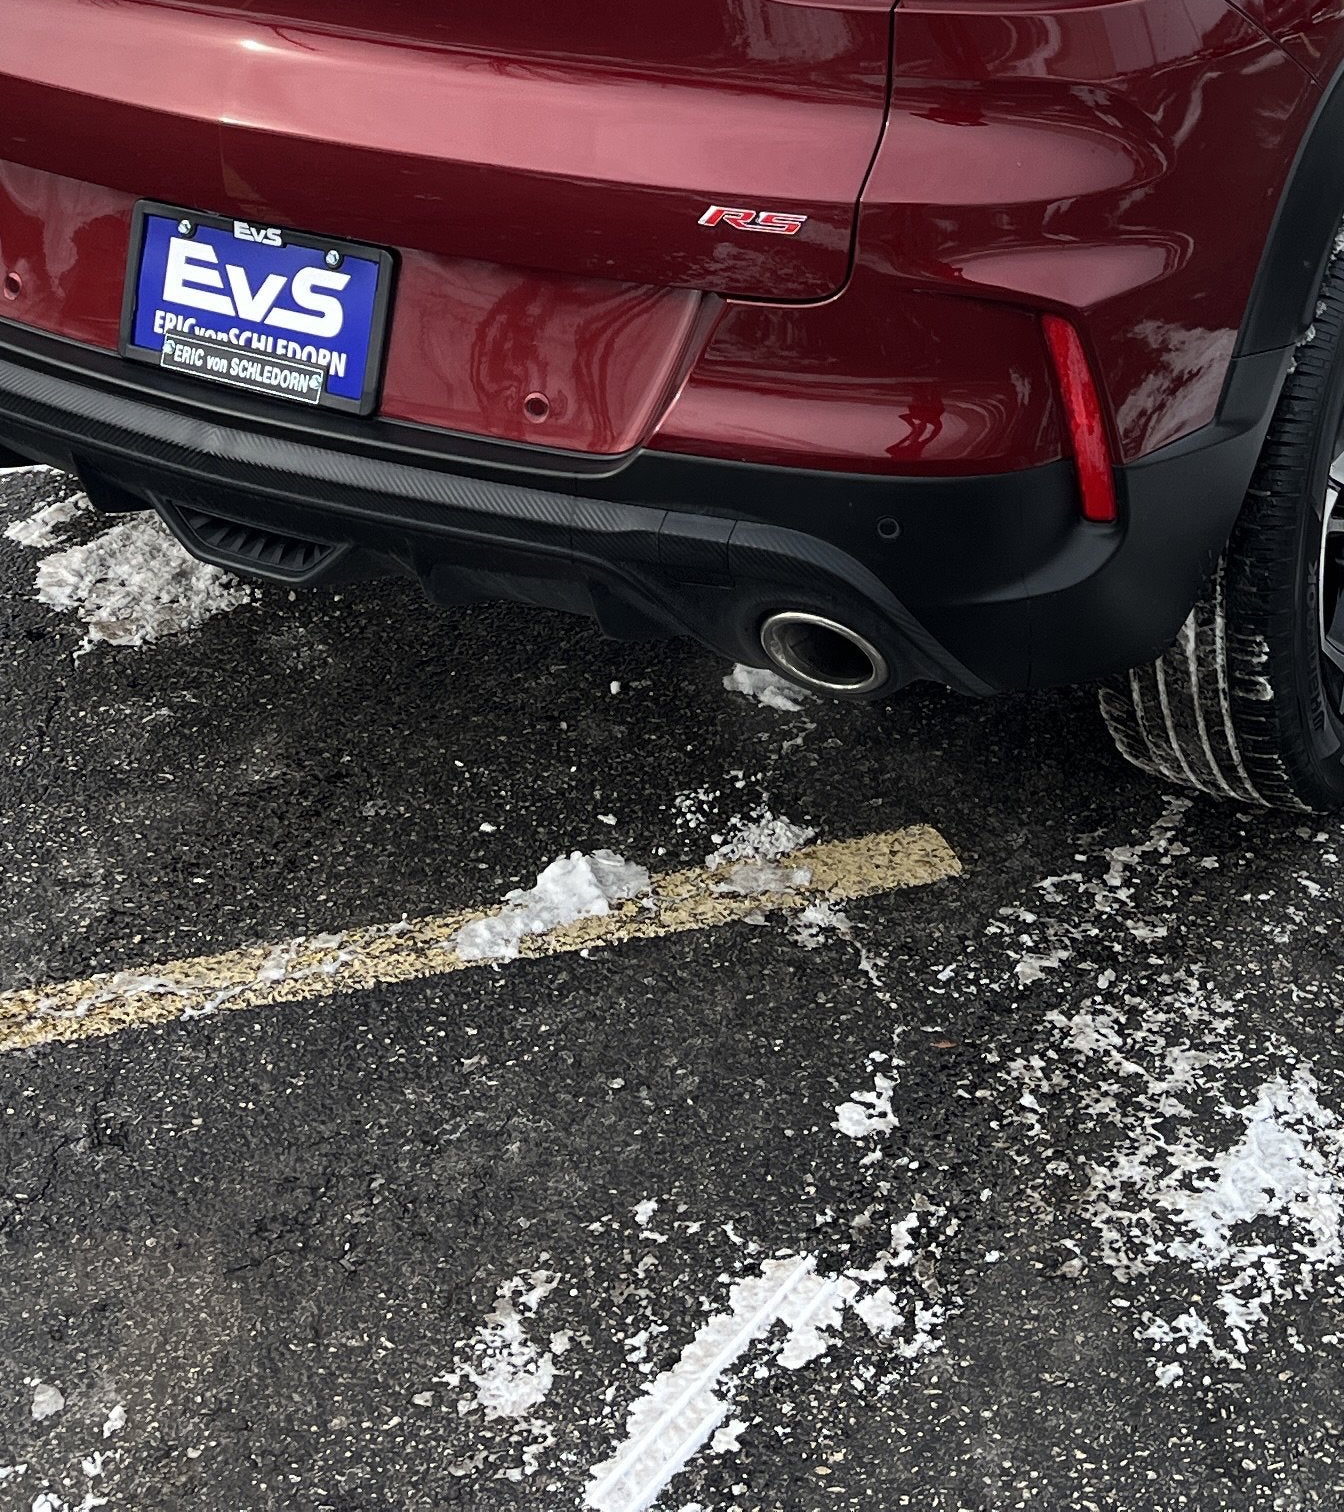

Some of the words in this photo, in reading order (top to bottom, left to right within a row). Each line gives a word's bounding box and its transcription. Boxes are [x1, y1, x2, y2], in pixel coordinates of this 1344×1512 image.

[697, 205, 808, 235] RS
[154, 310, 196, 334] ERIC
[174, 344, 205, 367] ERIC
[207, 355, 228, 373] von
[230, 358, 310, 393] SCHLEDORN
